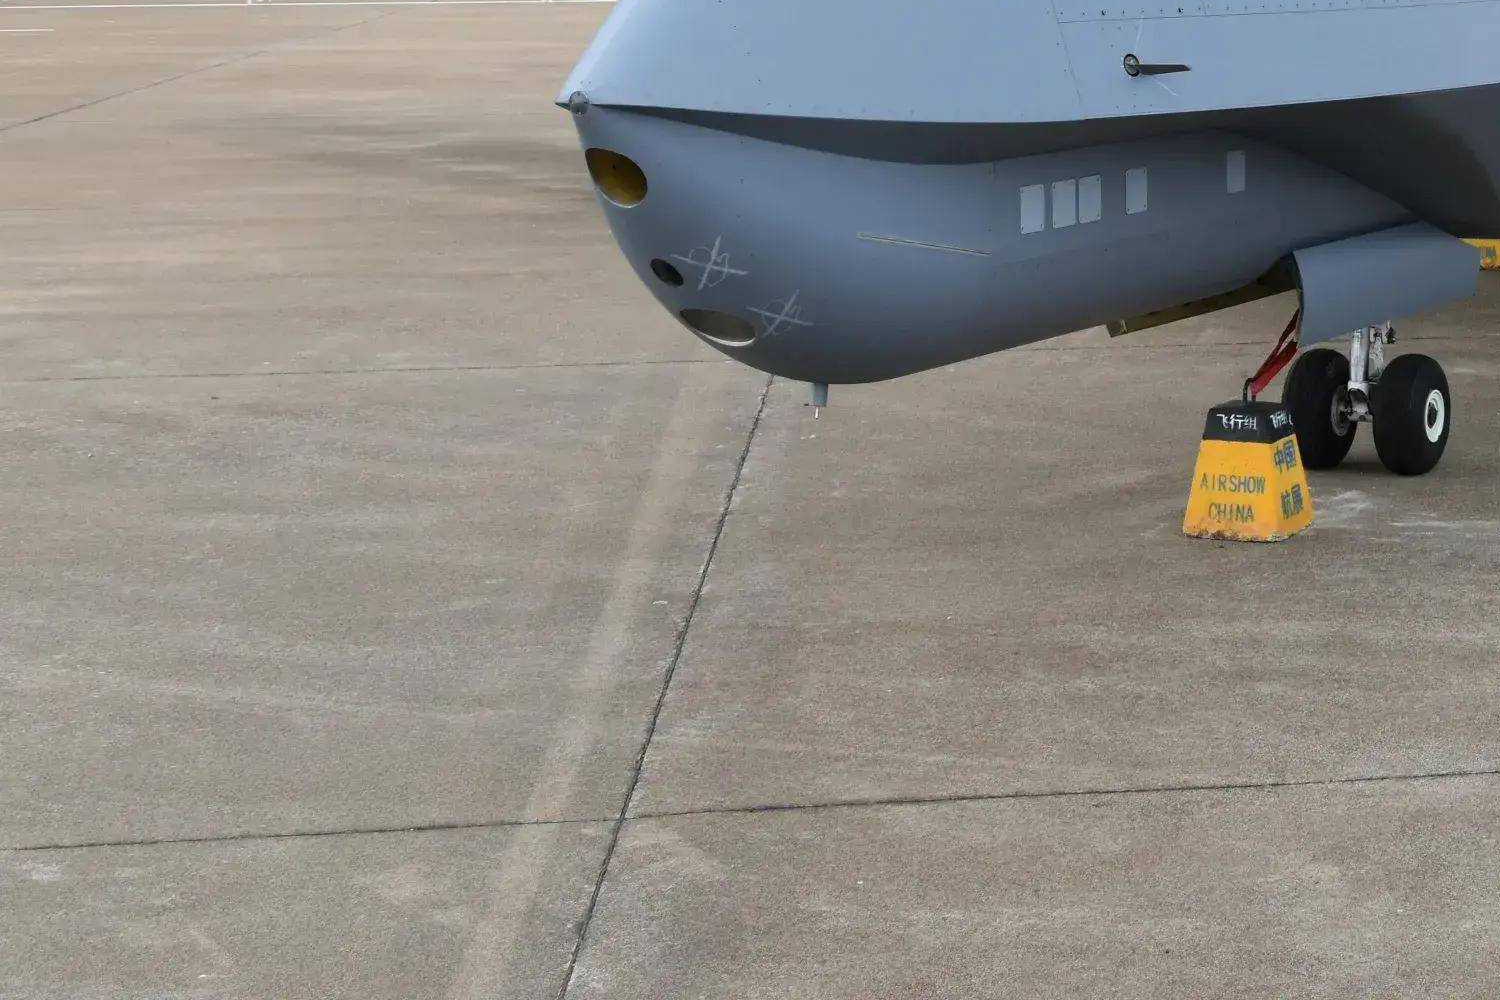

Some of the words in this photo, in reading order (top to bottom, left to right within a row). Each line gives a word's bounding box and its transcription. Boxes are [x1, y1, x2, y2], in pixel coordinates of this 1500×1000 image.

[1216, 412, 1258, 430] 飞行组
[1273, 440, 1298, 474] 中国
[1200, 472, 1266, 495] AIRSHOW
[1208, 501, 1256, 523] CHINA
